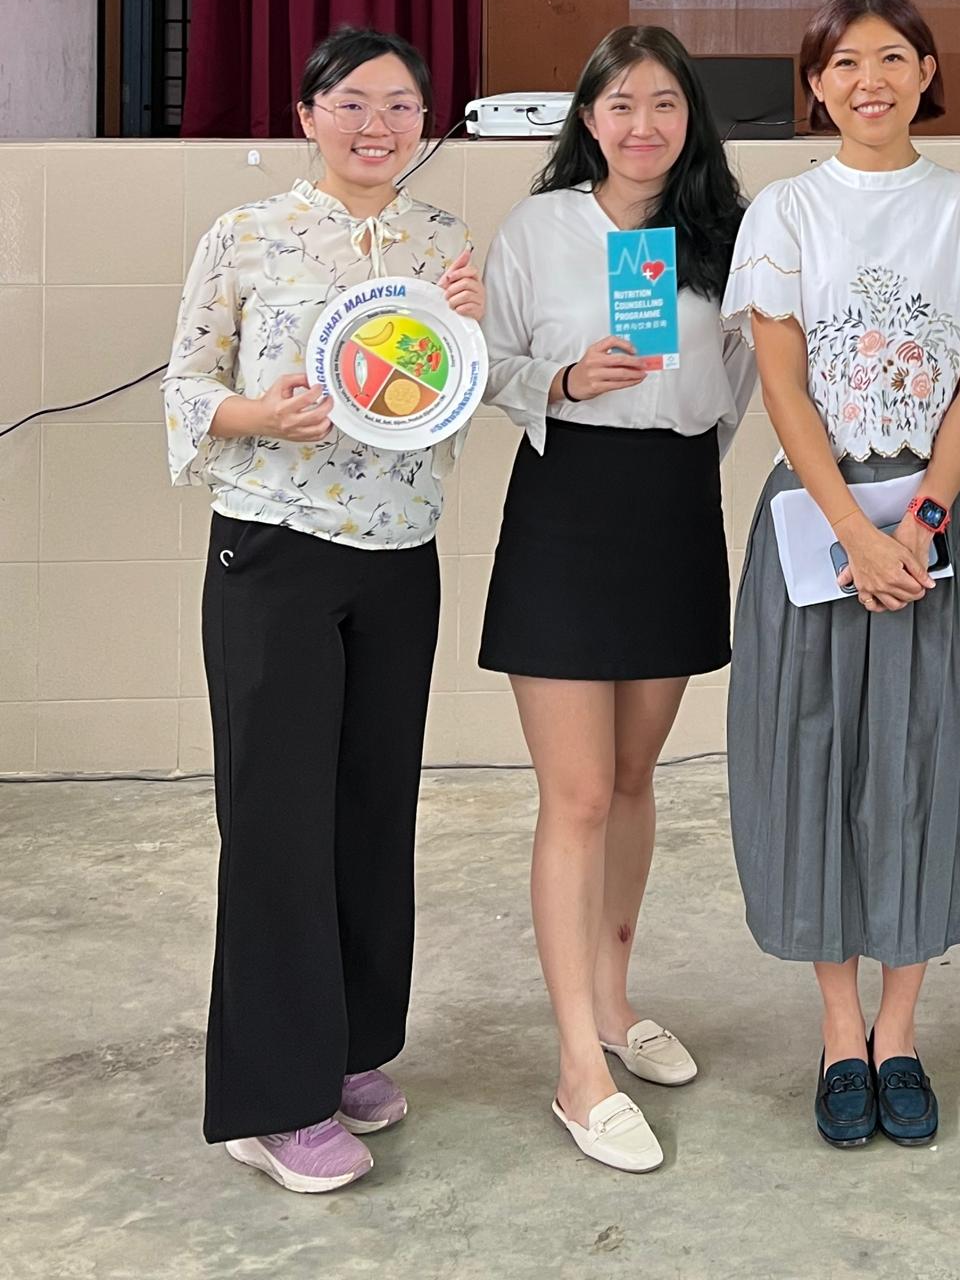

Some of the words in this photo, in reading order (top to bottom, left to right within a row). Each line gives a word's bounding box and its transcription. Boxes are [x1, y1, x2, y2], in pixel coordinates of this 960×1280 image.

[613, 289, 652, 300] NUTRITION
[319, 309, 344, 346] SIHAT
[343, 284, 406, 314] MALAYSIA
[614, 309, 661, 322] PROGRAMME
